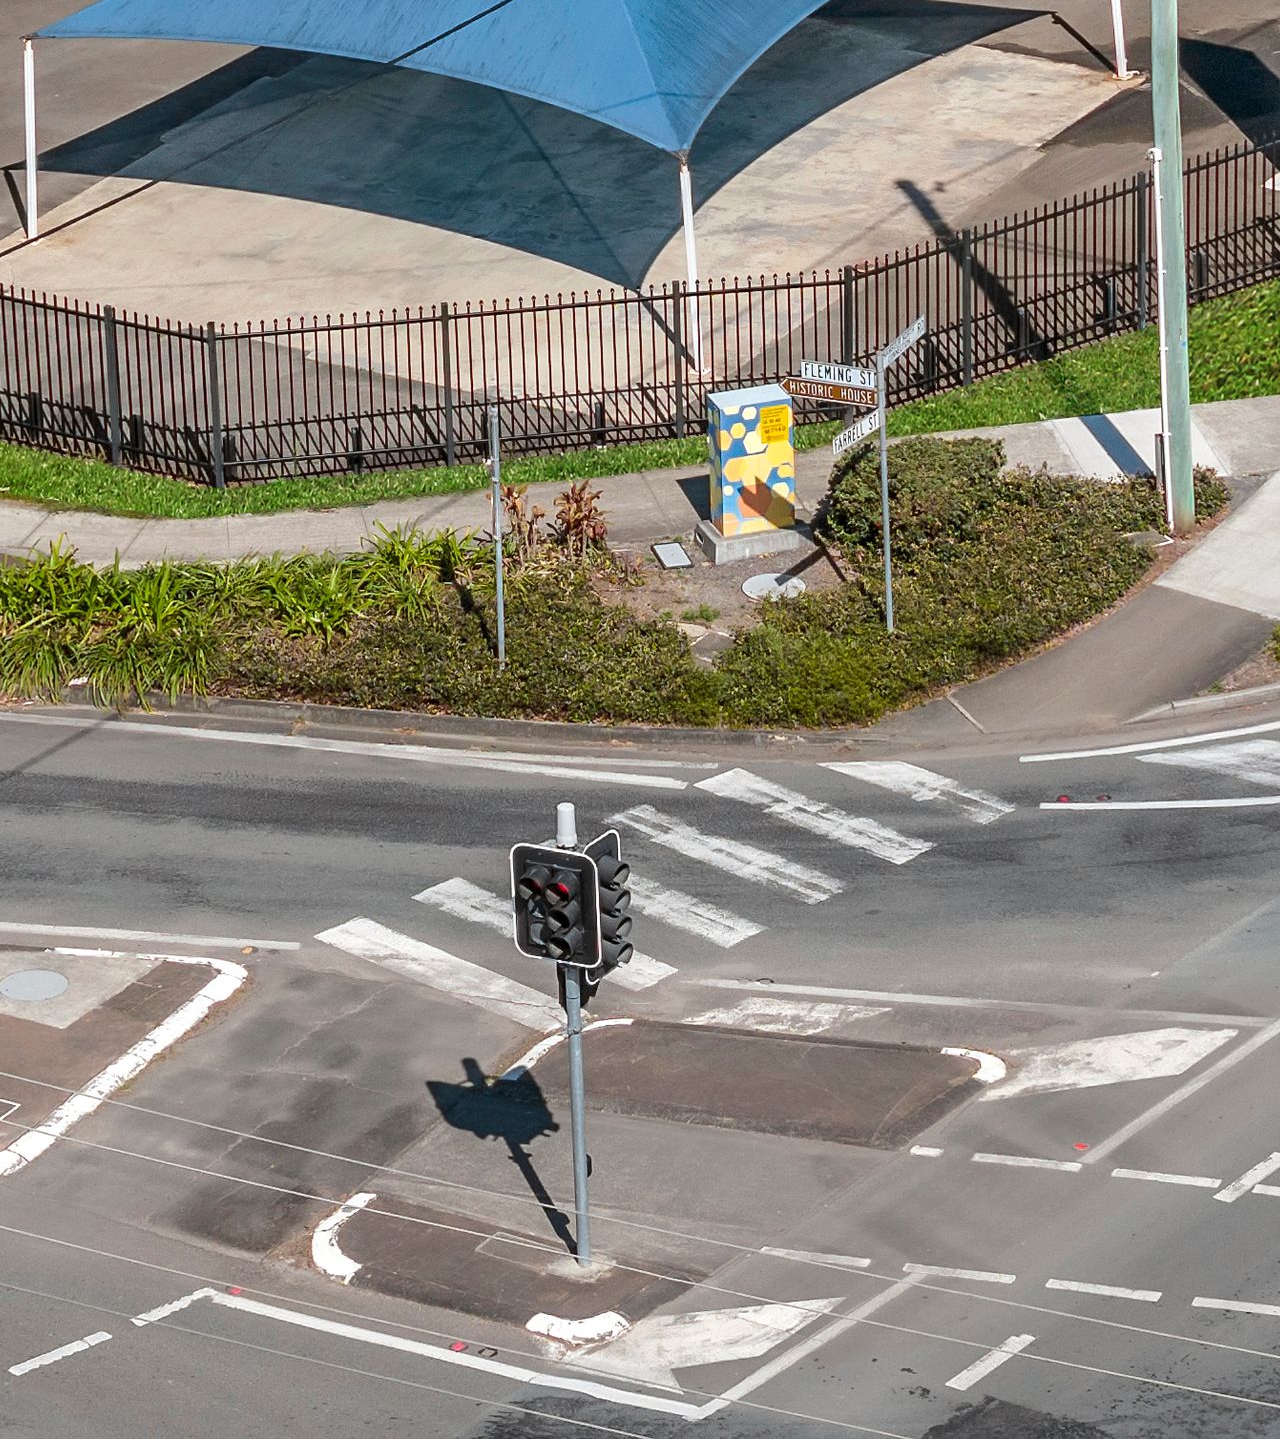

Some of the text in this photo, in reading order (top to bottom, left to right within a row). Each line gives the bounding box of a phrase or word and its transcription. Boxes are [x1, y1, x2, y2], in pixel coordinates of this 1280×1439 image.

[804, 363, 873, 386] FLEMING ST
[789, 380, 873, 404] HISTORIC HOUSE
[834, 413, 879, 454] FARRELL ST
